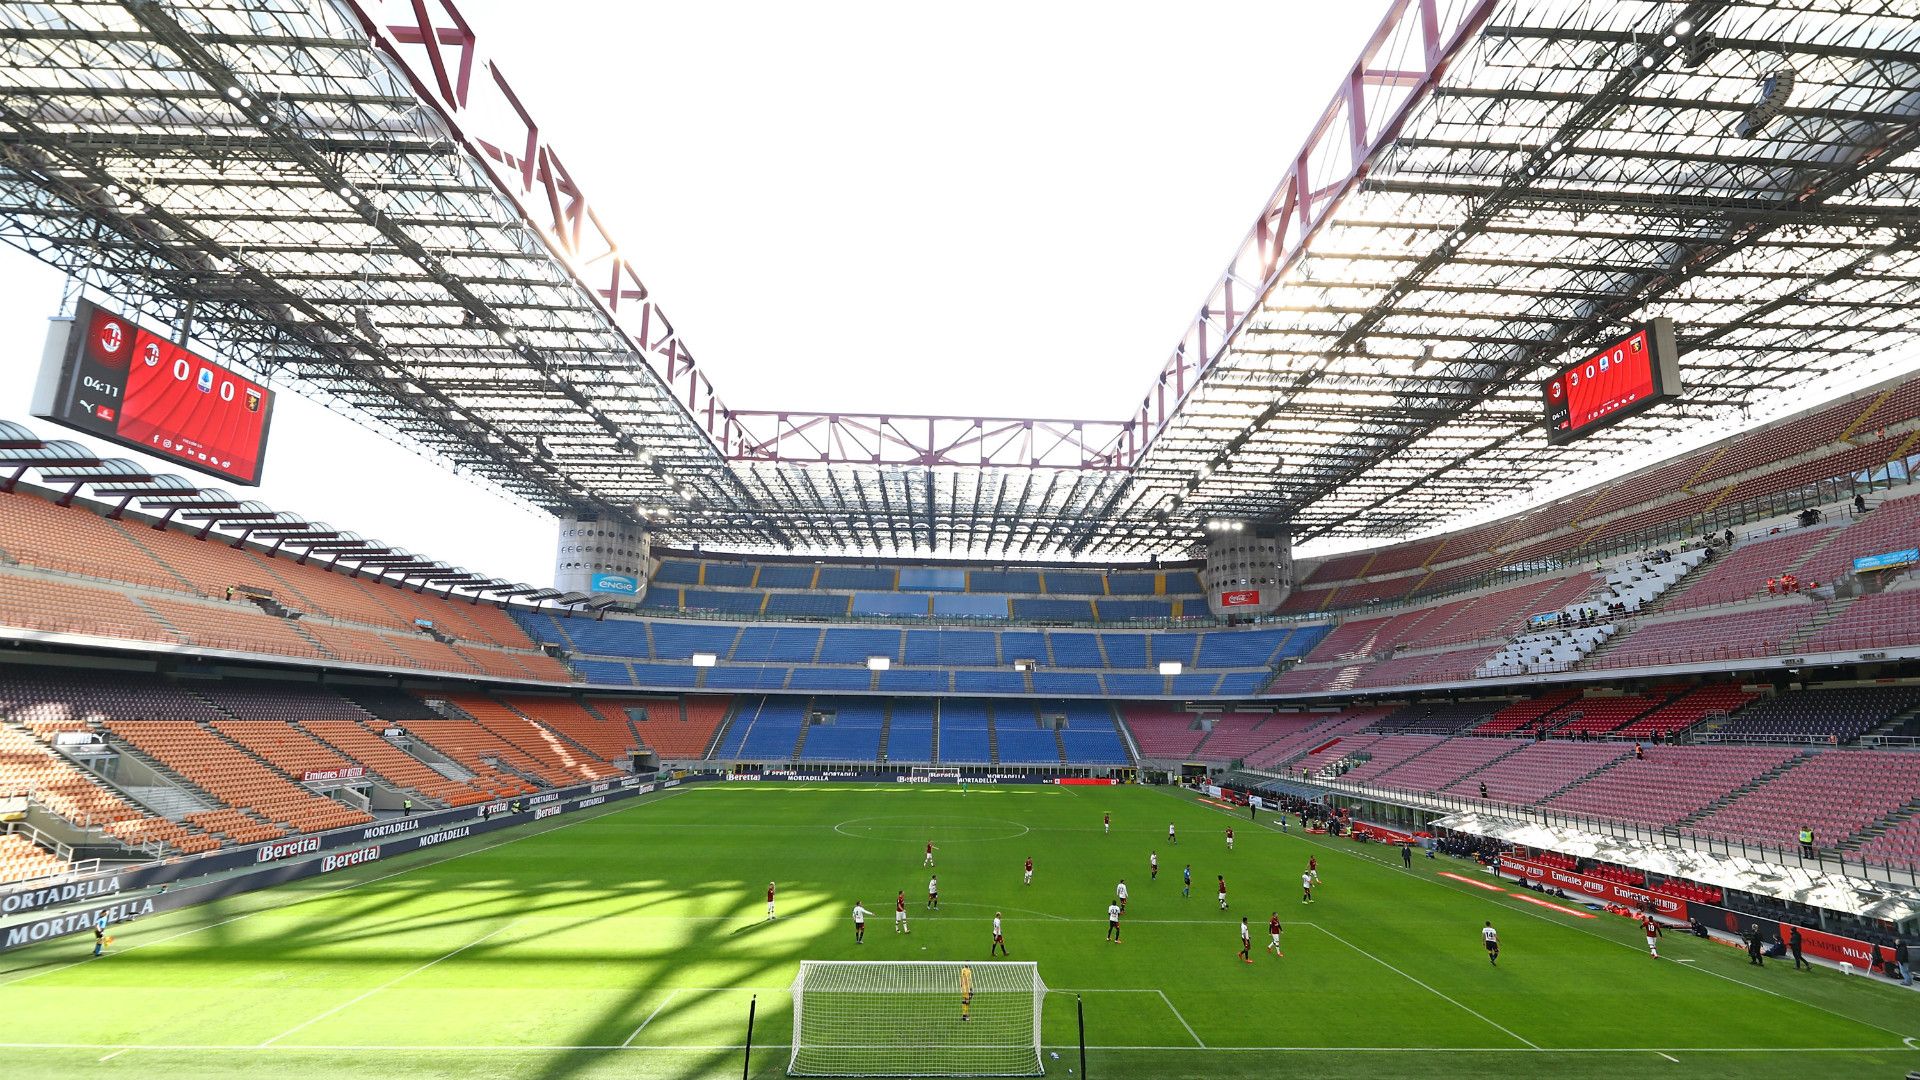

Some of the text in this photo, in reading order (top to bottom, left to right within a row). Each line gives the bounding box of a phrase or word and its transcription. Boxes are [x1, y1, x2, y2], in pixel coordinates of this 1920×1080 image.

[1613, 350, 1624, 364] 0
[173, 359, 190, 381] 0
[1585, 365, 1596, 379] 0
[83, 376, 119, 398] 04:11
[220, 381, 235, 402] 0
[304, 771, 338, 781] Emirates
[363, 820, 419, 840] MORTADELLA
[419, 827, 470, 848] MORTADELLA
[257, 837, 321, 863] Beretta
[321, 846, 380, 873] Beretta
[1551, 871, 1582, 886] Emirates
